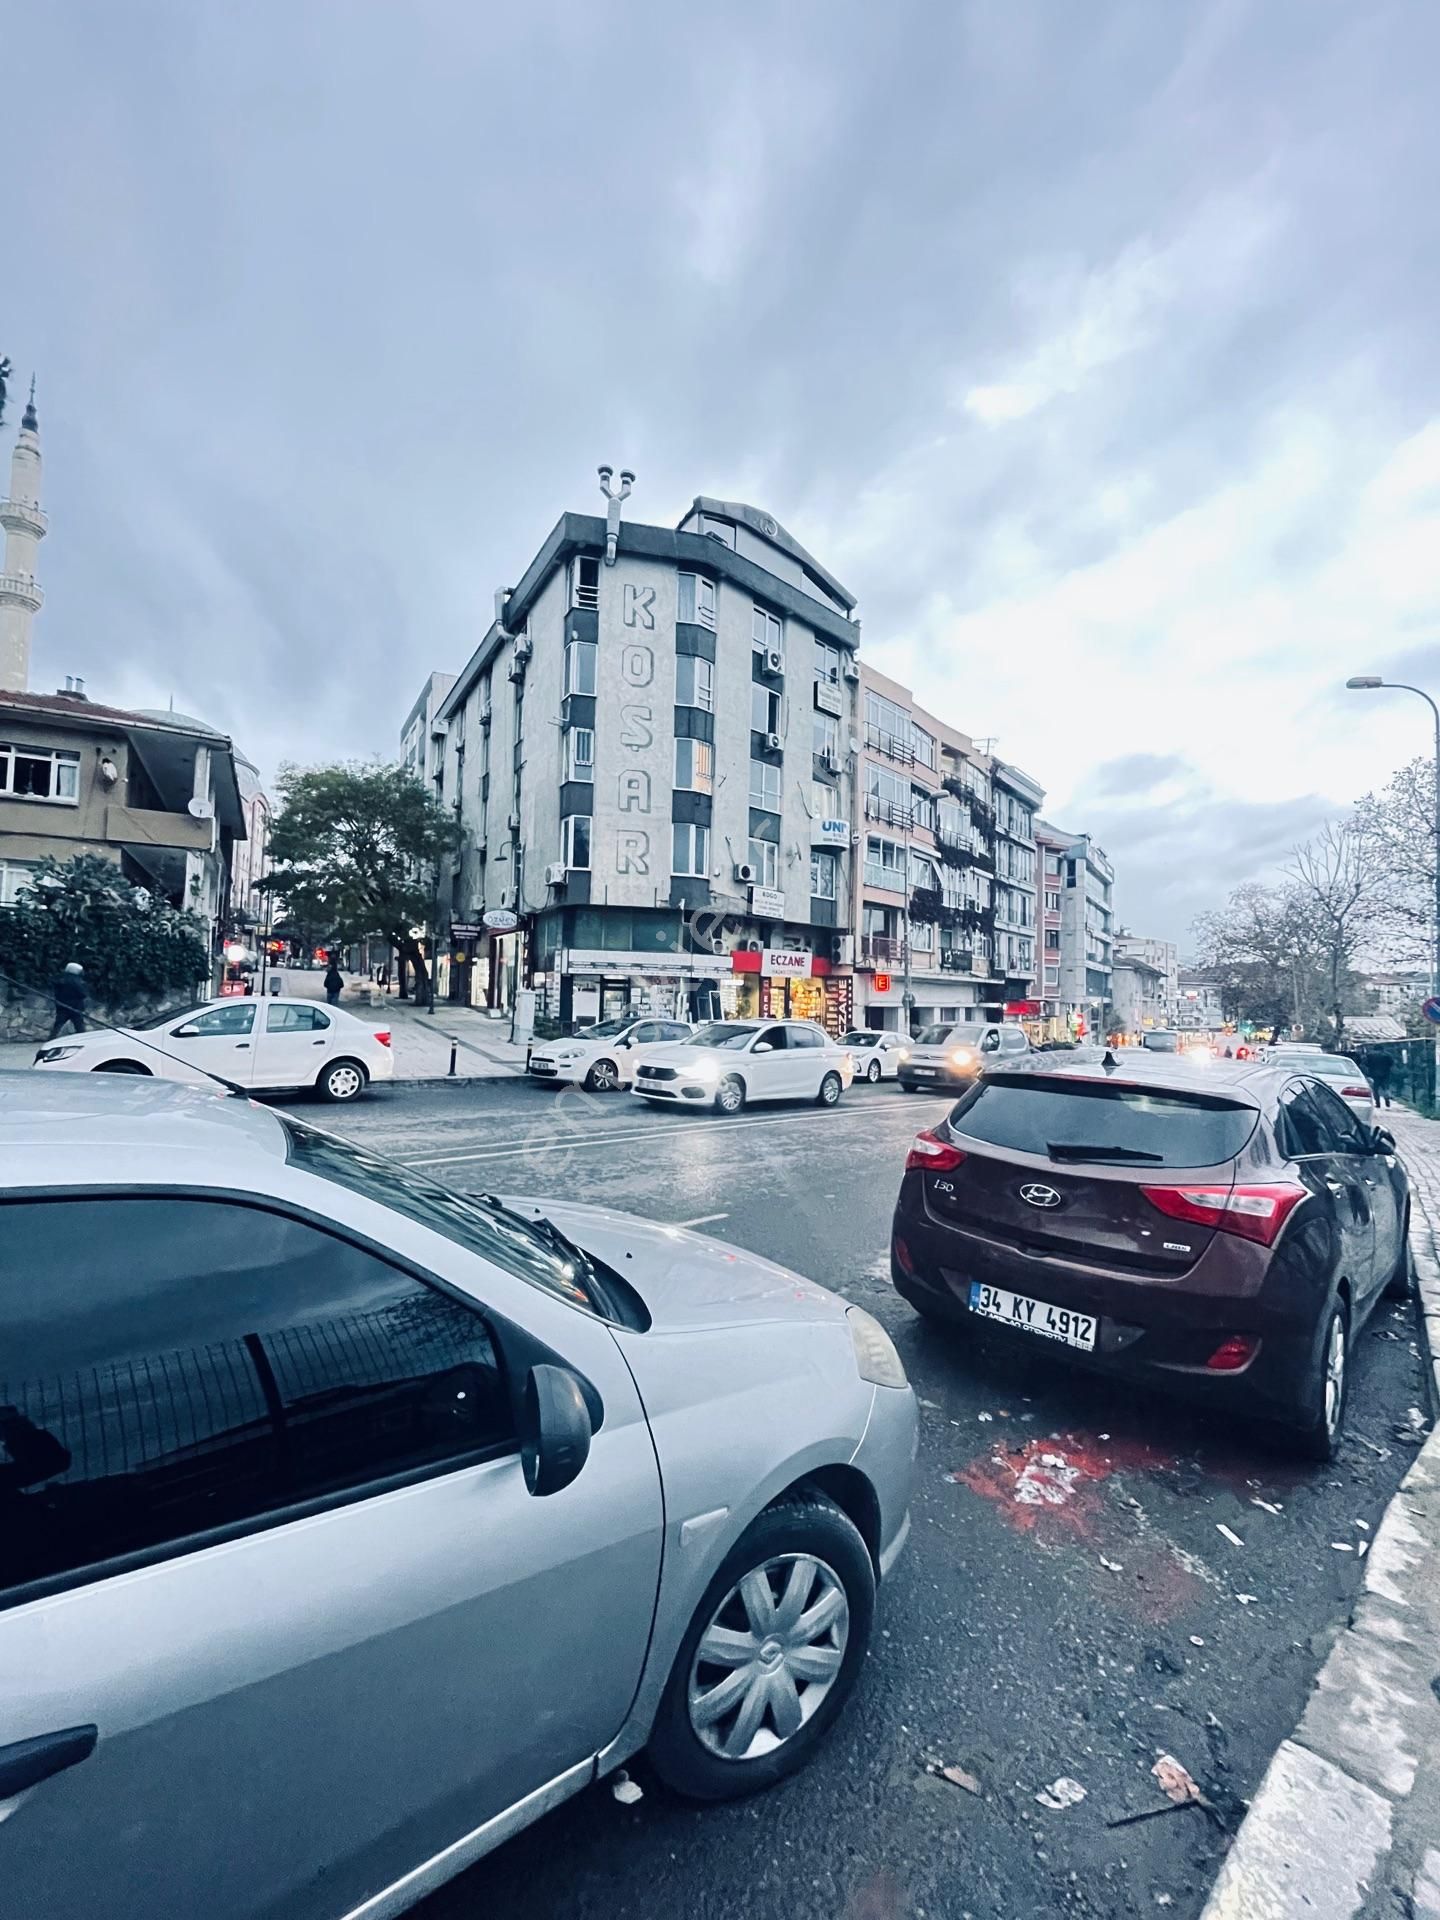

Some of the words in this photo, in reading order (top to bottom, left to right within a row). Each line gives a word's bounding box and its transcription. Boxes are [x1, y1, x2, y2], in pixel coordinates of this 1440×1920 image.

[616, 583, 656, 876] KOŞAR
[770, 954, 806, 968] ECZANE
[838, 979, 847, 1035] CZANE
[980, 1287, 1001, 1313] 34
[1012, 1296, 1036, 1323] KY
[1046, 1307, 1092, 1342] 4912
